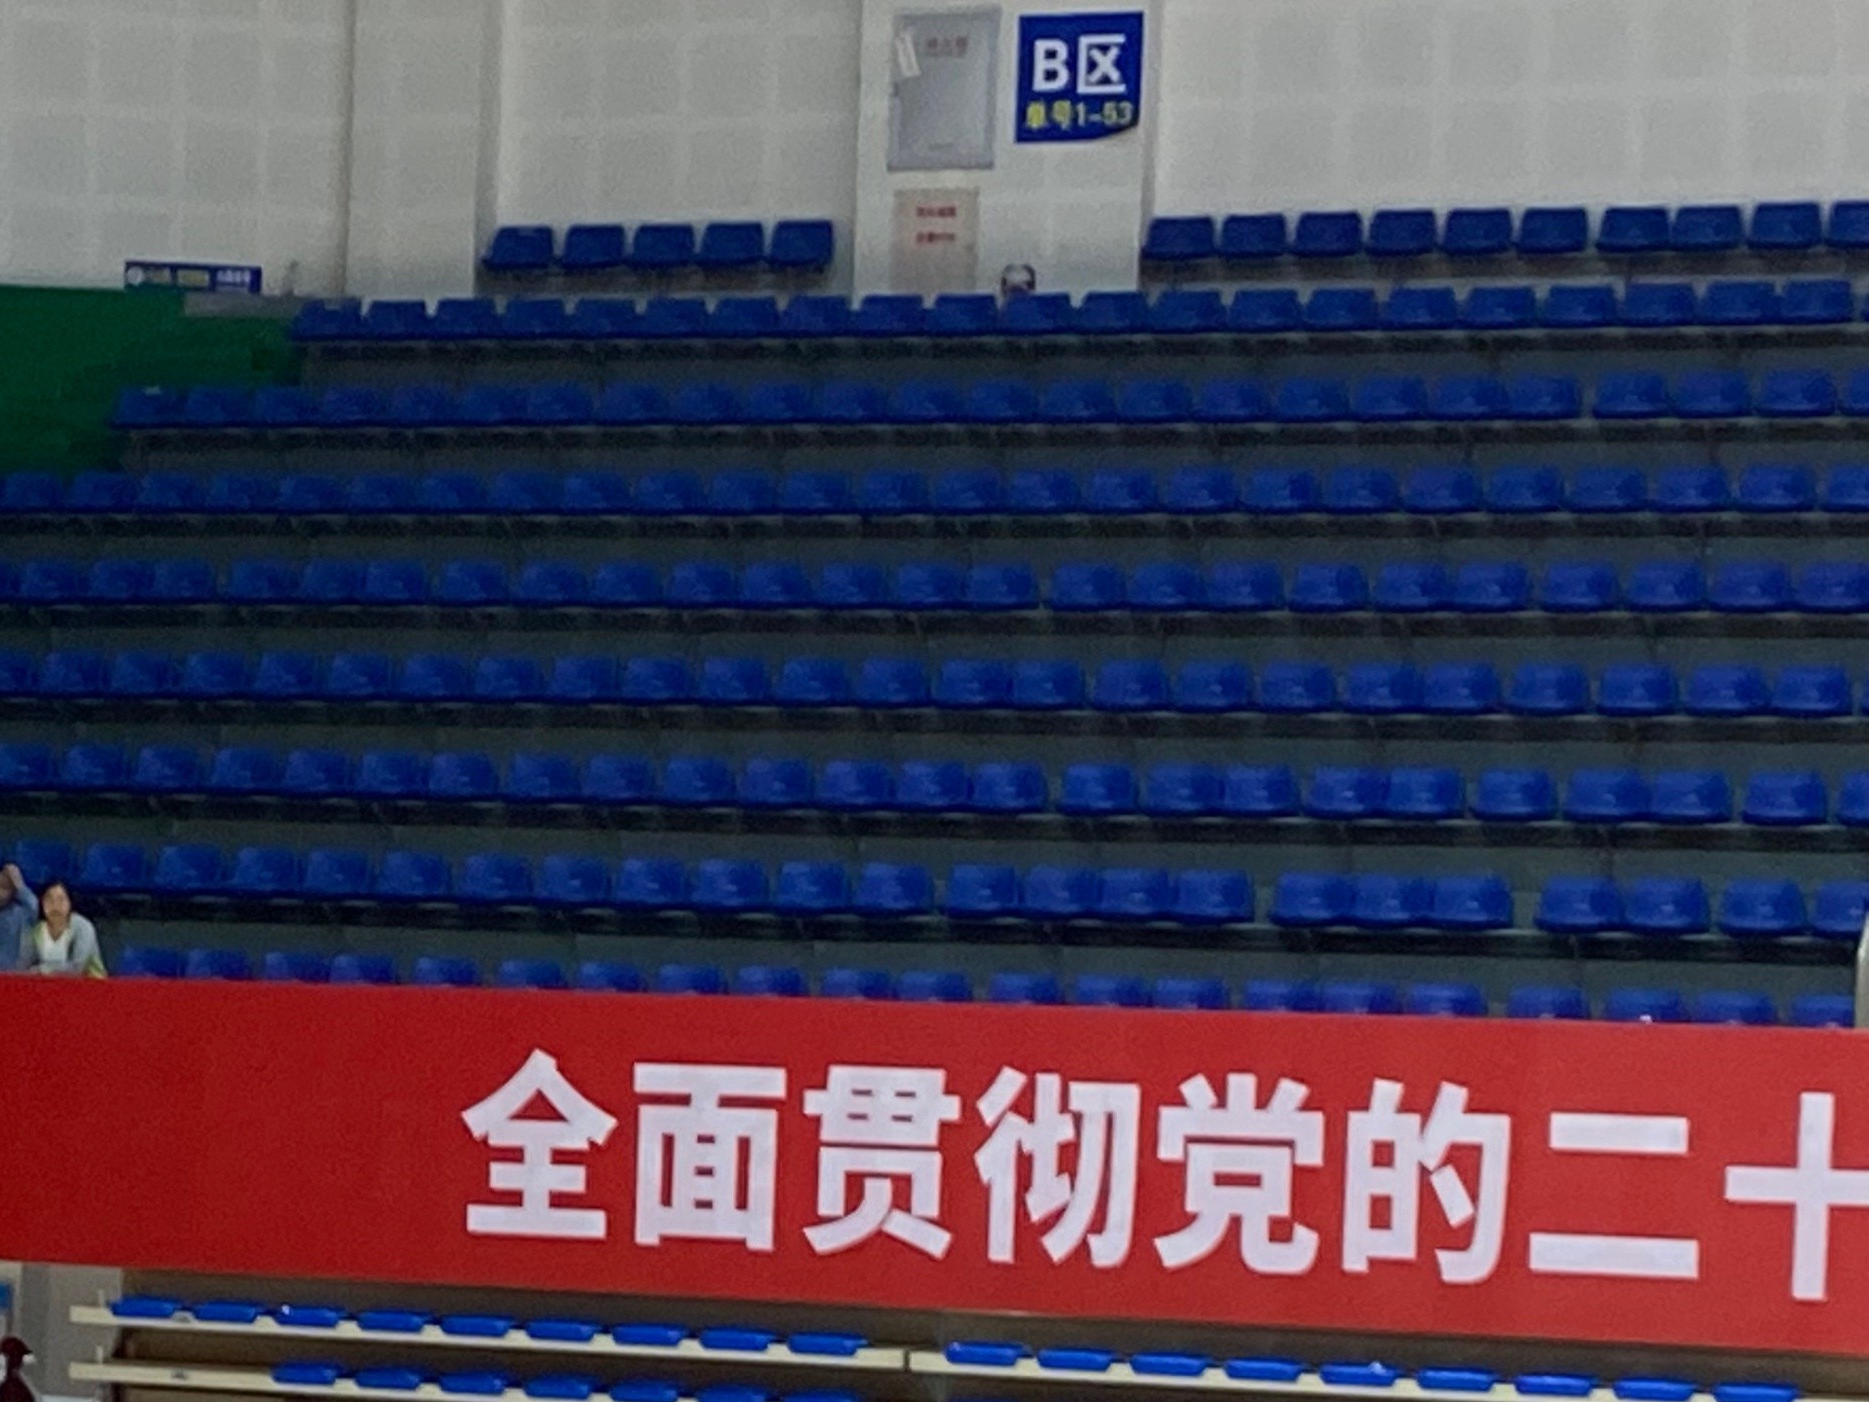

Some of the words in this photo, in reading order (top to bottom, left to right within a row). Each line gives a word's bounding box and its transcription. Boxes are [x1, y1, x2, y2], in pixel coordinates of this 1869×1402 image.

[1033, 34, 1126, 94] B区
[461, 1048, 1869, 1302] 全面贯彻党的二十
